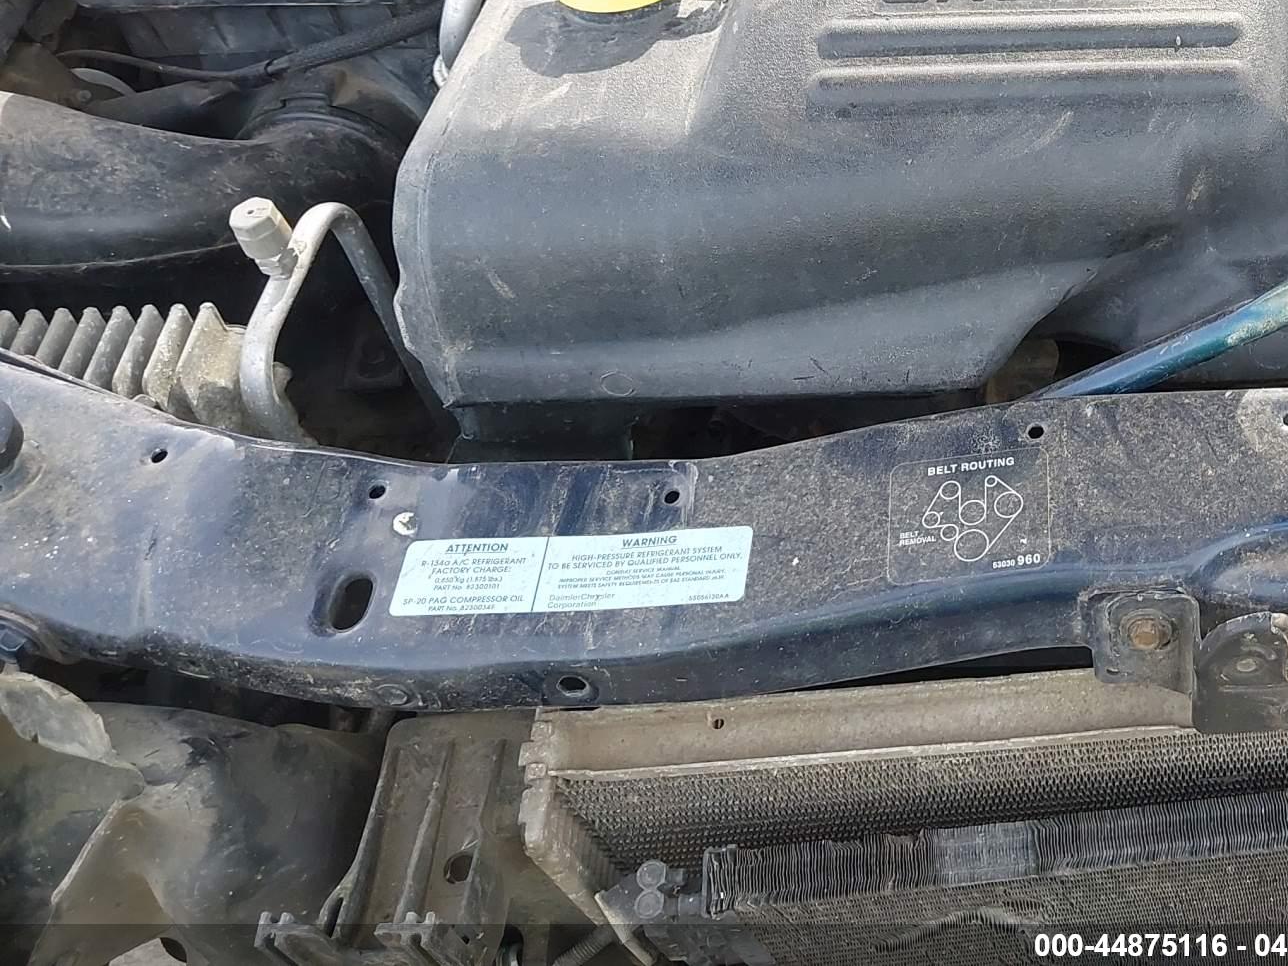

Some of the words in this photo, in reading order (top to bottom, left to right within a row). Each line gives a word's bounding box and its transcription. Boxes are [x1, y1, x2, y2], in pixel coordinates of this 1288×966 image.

[927, 464, 958, 476] BELT
[961, 457, 1015, 471] ROUTING
[899, 530, 919, 538] BELT
[622, 535, 678, 547] WARNING
[899, 535, 937, 545] REMOVAL
[445, 542, 509, 553] ATTENTION
[571, 551, 635, 561] HIGH-PRESSURE
[636, 548, 690, 558] REFRIGERANT
[692, 545, 723, 554] SYSTEM
[452, 559, 469, 567] A/C
[472, 557, 527, 566] REFRIGERANT
[548, 562, 560, 570] TO
[572, 560, 613, 569] SERVICED
[627, 556, 669, 566] QUALIFIED
[670, 554, 718, 564] PERSONNEL
[1017, 553, 1041, 566] 960
[431, 566, 471, 575] FACTORY
[428, 596, 448, 604] PAG
[449, 595, 508, 604] COMPRESSOR
[509, 594, 524, 602] OIL
[549, 593, 616, 602] DaimlerChrysler
[547, 601, 597, 609] Corporation
